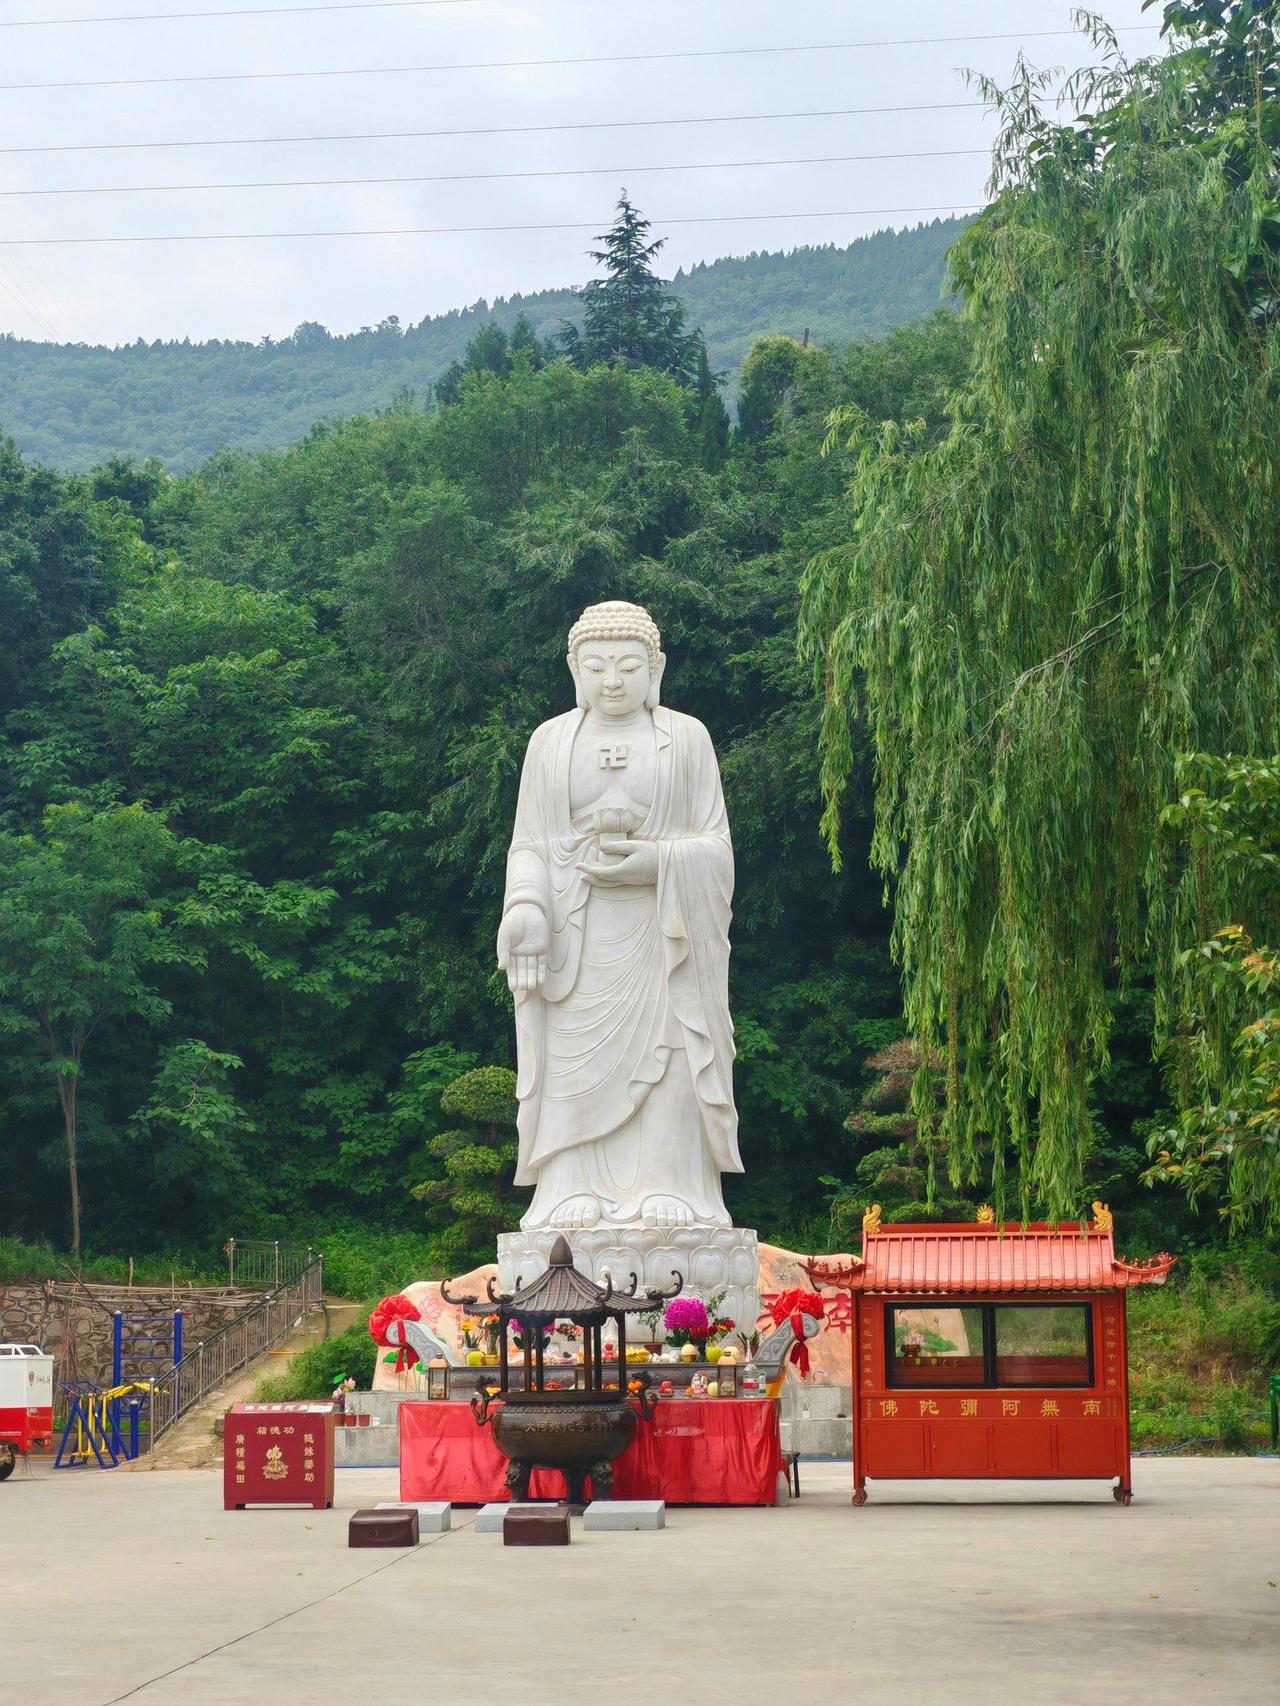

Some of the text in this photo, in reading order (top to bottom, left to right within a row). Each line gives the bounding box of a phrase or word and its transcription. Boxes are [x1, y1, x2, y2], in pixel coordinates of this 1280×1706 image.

[879, 1398, 1101, 1417] 南無阿彌陀佛
[235, 1434, 245, 1484] 廣種福田
